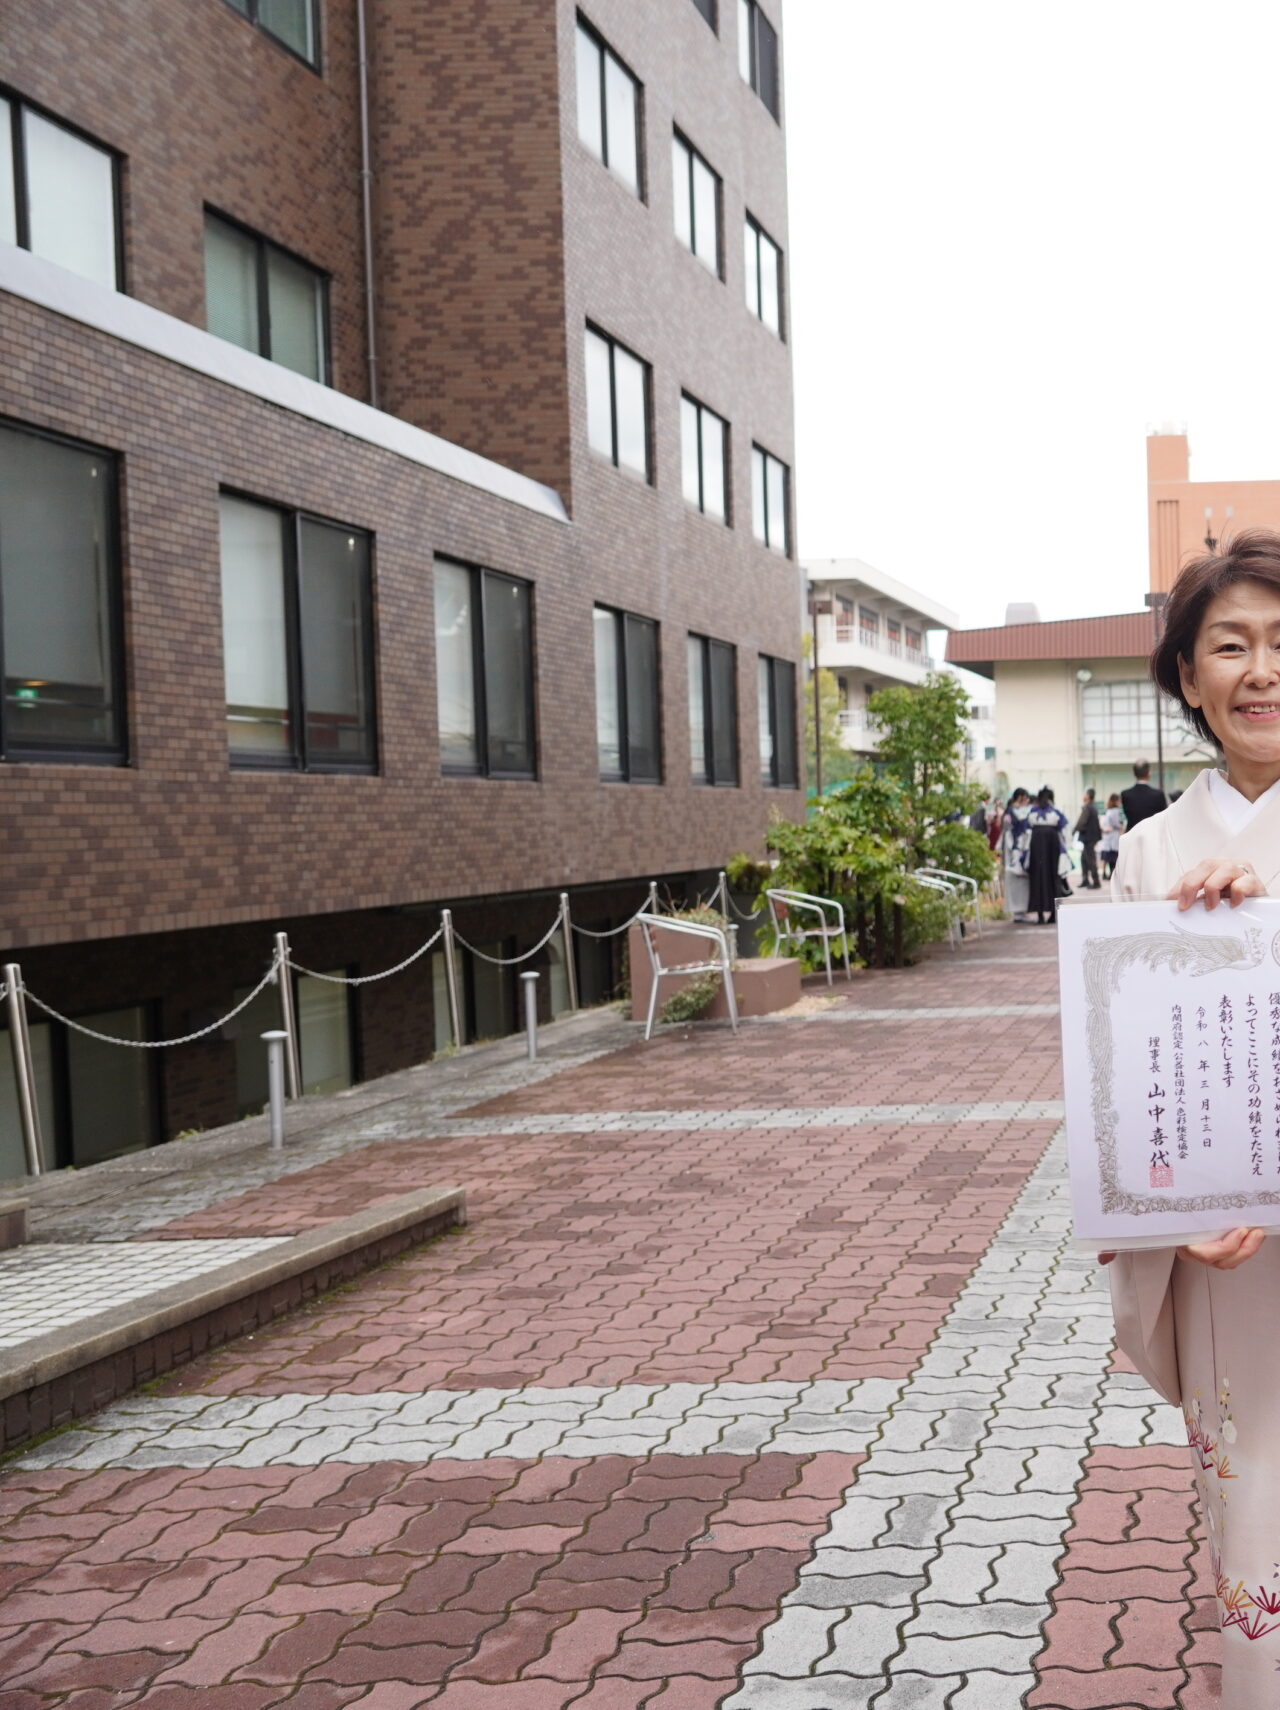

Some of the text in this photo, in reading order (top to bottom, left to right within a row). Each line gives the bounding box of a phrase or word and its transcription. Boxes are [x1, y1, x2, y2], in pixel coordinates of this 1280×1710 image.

[1148, 1036, 1161, 1073] 理事長
[1218, 994, 1235, 1087] 表彰いたします
[1245, 993, 1264, 1176] よってここにその功績をたたえ
[1147, 1082, 1170, 1168] 山中喜代
